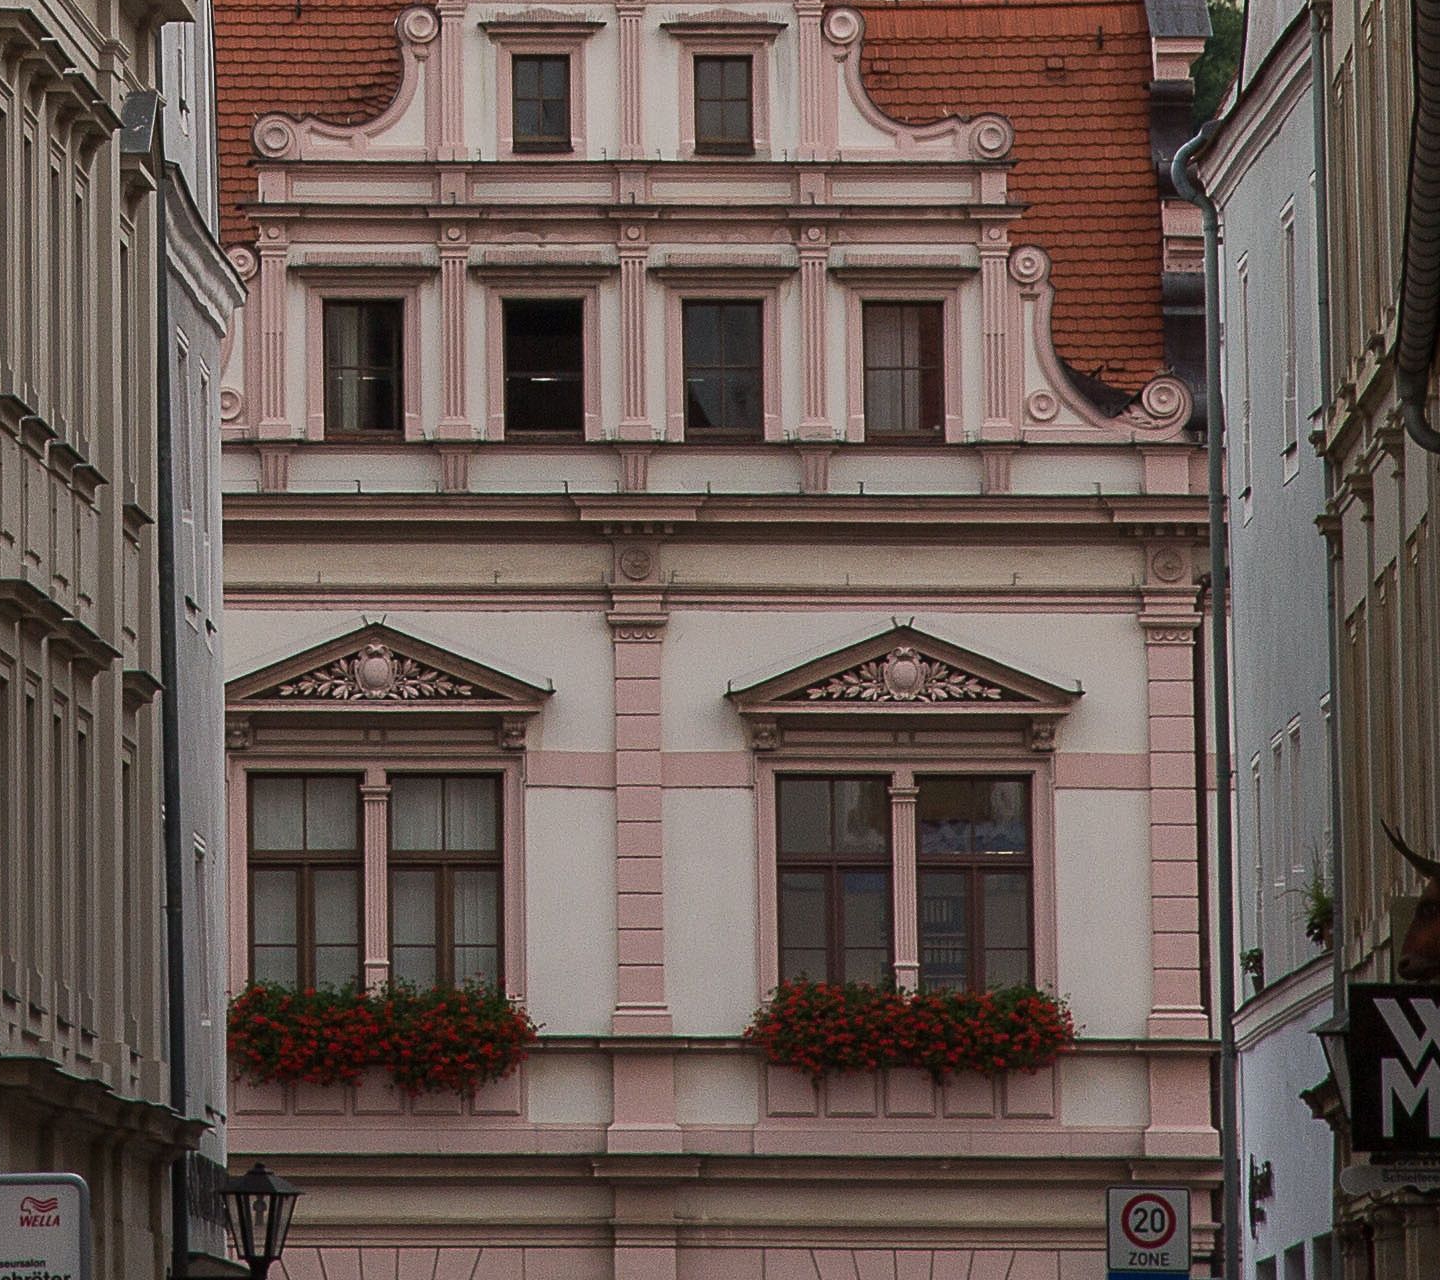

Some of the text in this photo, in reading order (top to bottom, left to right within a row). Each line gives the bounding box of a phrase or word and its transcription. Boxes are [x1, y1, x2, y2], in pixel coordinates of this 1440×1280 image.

[19, 1215, 60, 1227] WELLA
[1133, 1207, 1166, 1234] 20
[1128, 1251, 1170, 1267] ZONE
